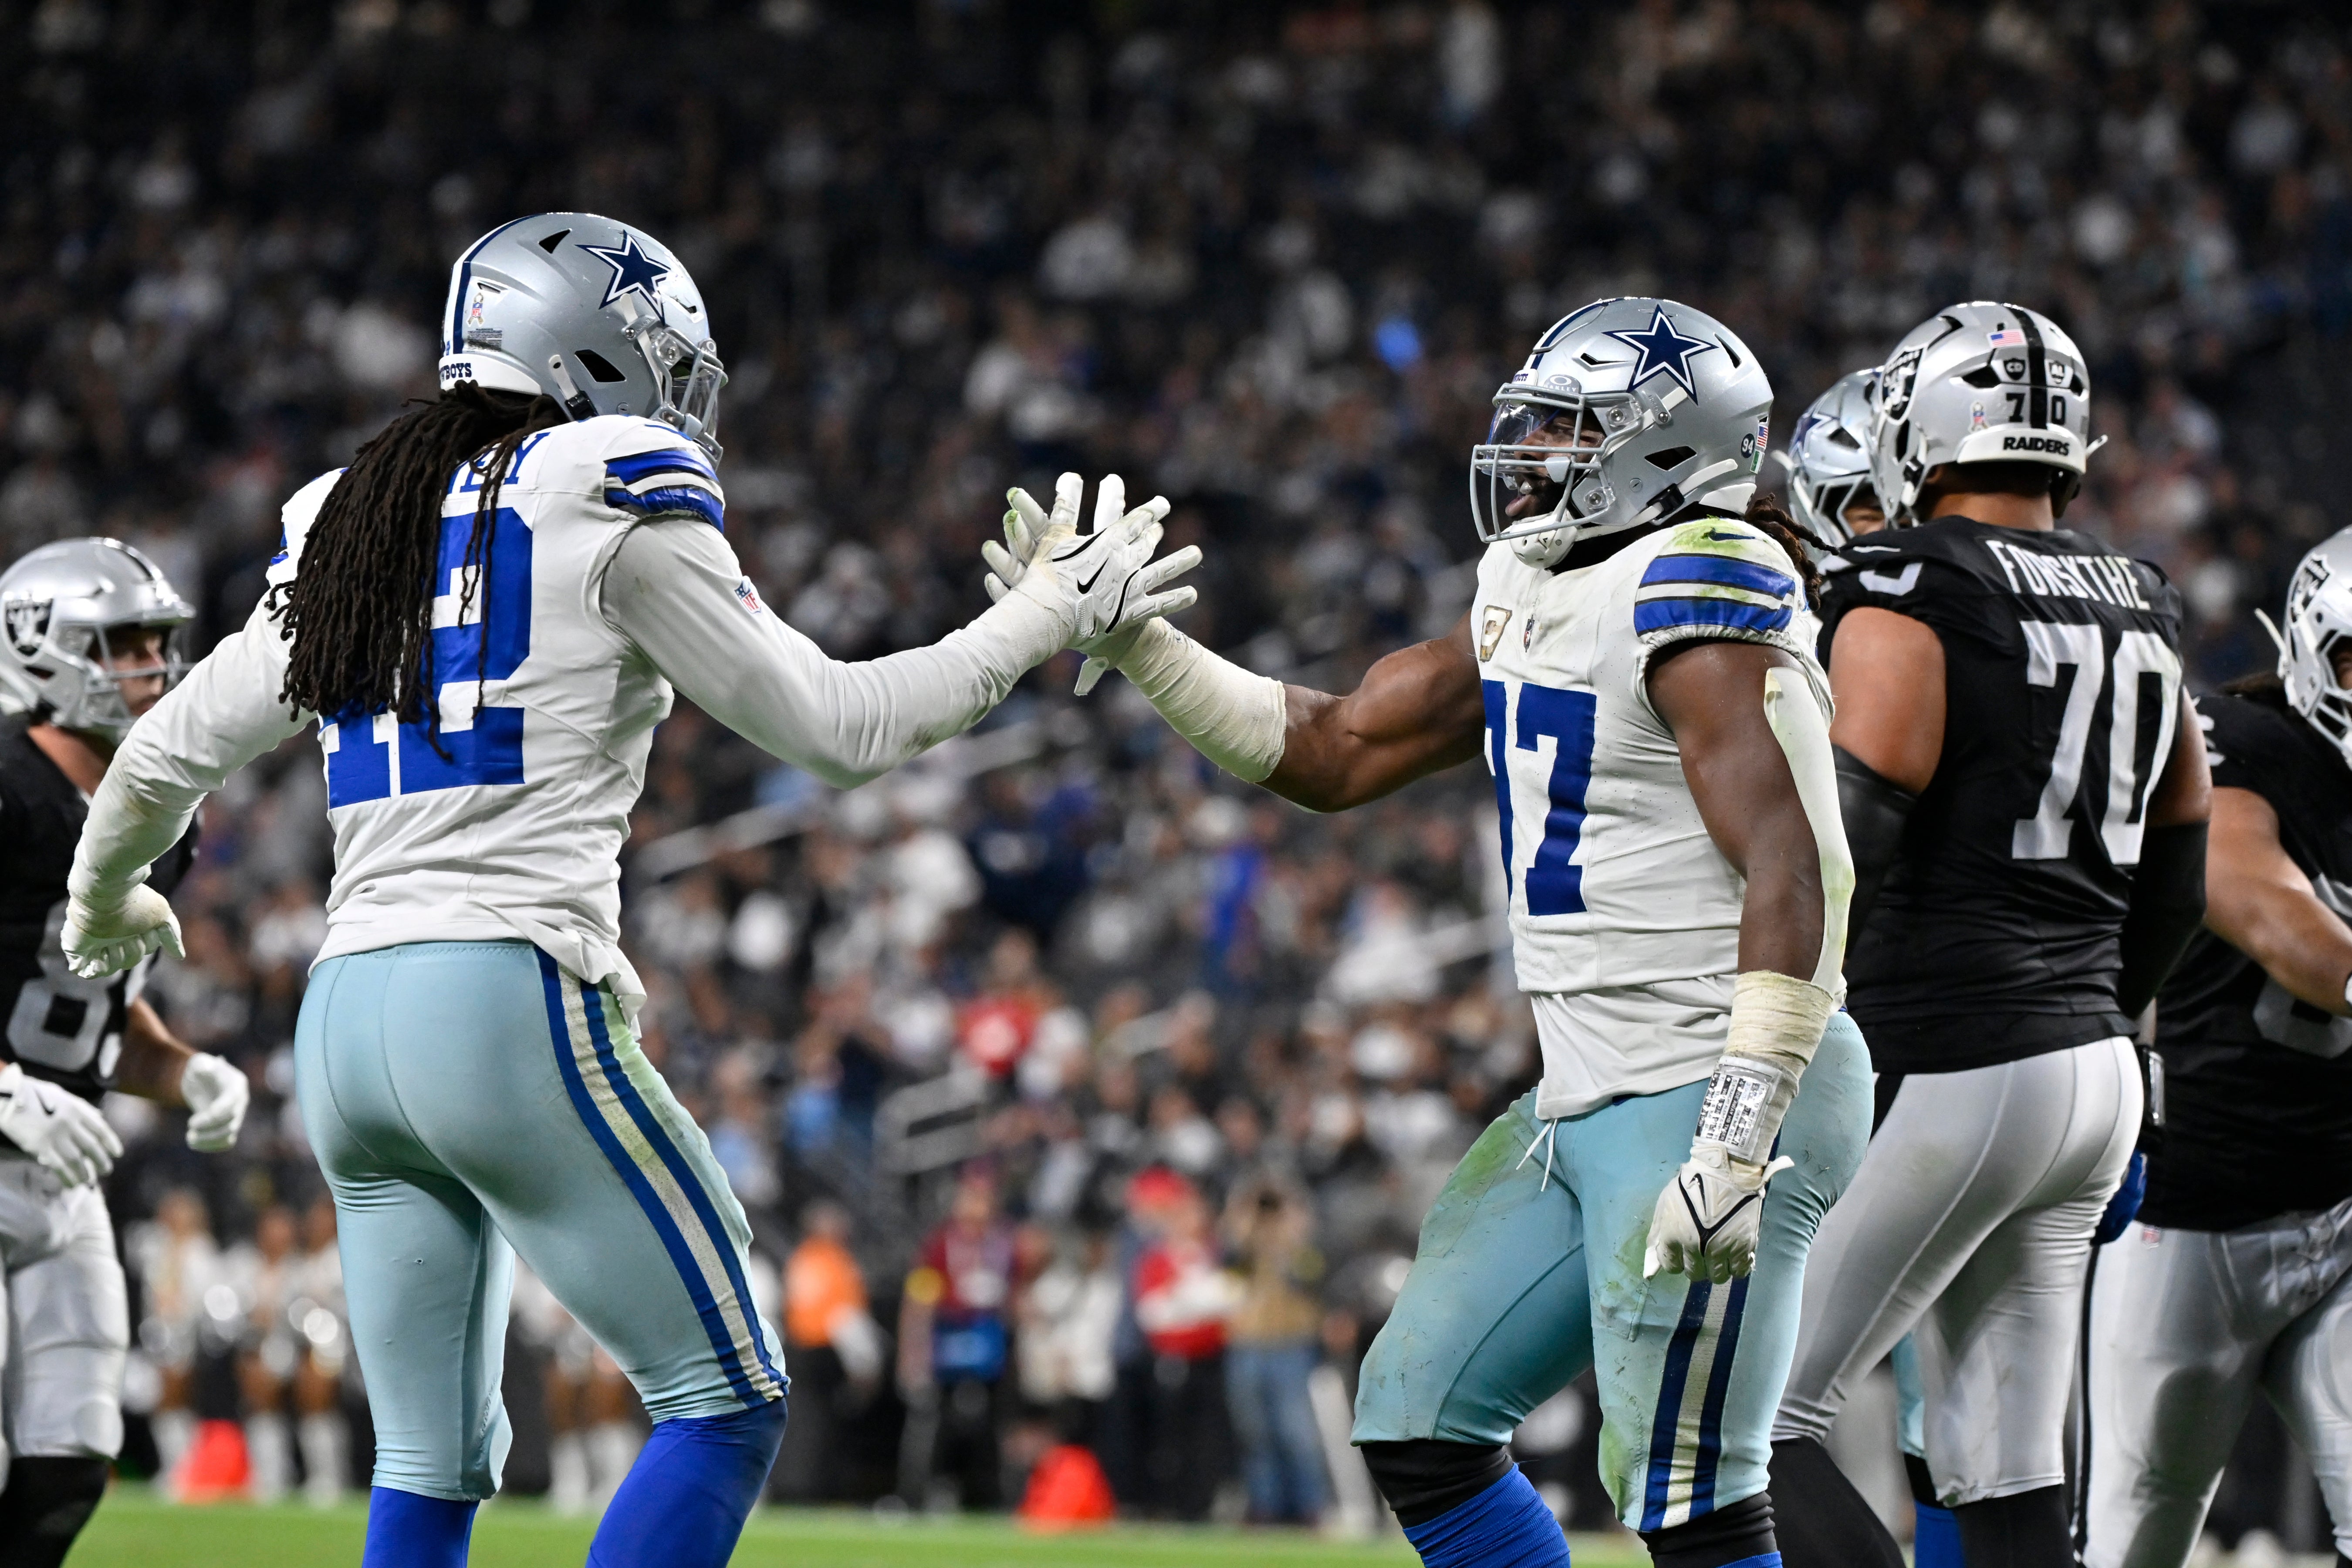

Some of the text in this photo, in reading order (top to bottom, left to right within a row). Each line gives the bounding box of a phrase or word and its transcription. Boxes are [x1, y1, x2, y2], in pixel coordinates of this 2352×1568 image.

[440, 362, 472, 380] BOYS
[2006, 393, 2026, 422] 7
[1742, 438, 1754, 454] 94
[2003, 437, 2071, 456] RAIDERS
[1985, 540, 2151, 610] FORSYTHE
[2011, 620, 2182, 865] 70
[1728, 1100, 1737, 1115] AWAY
[1726, 1115, 1732, 1123] HB
